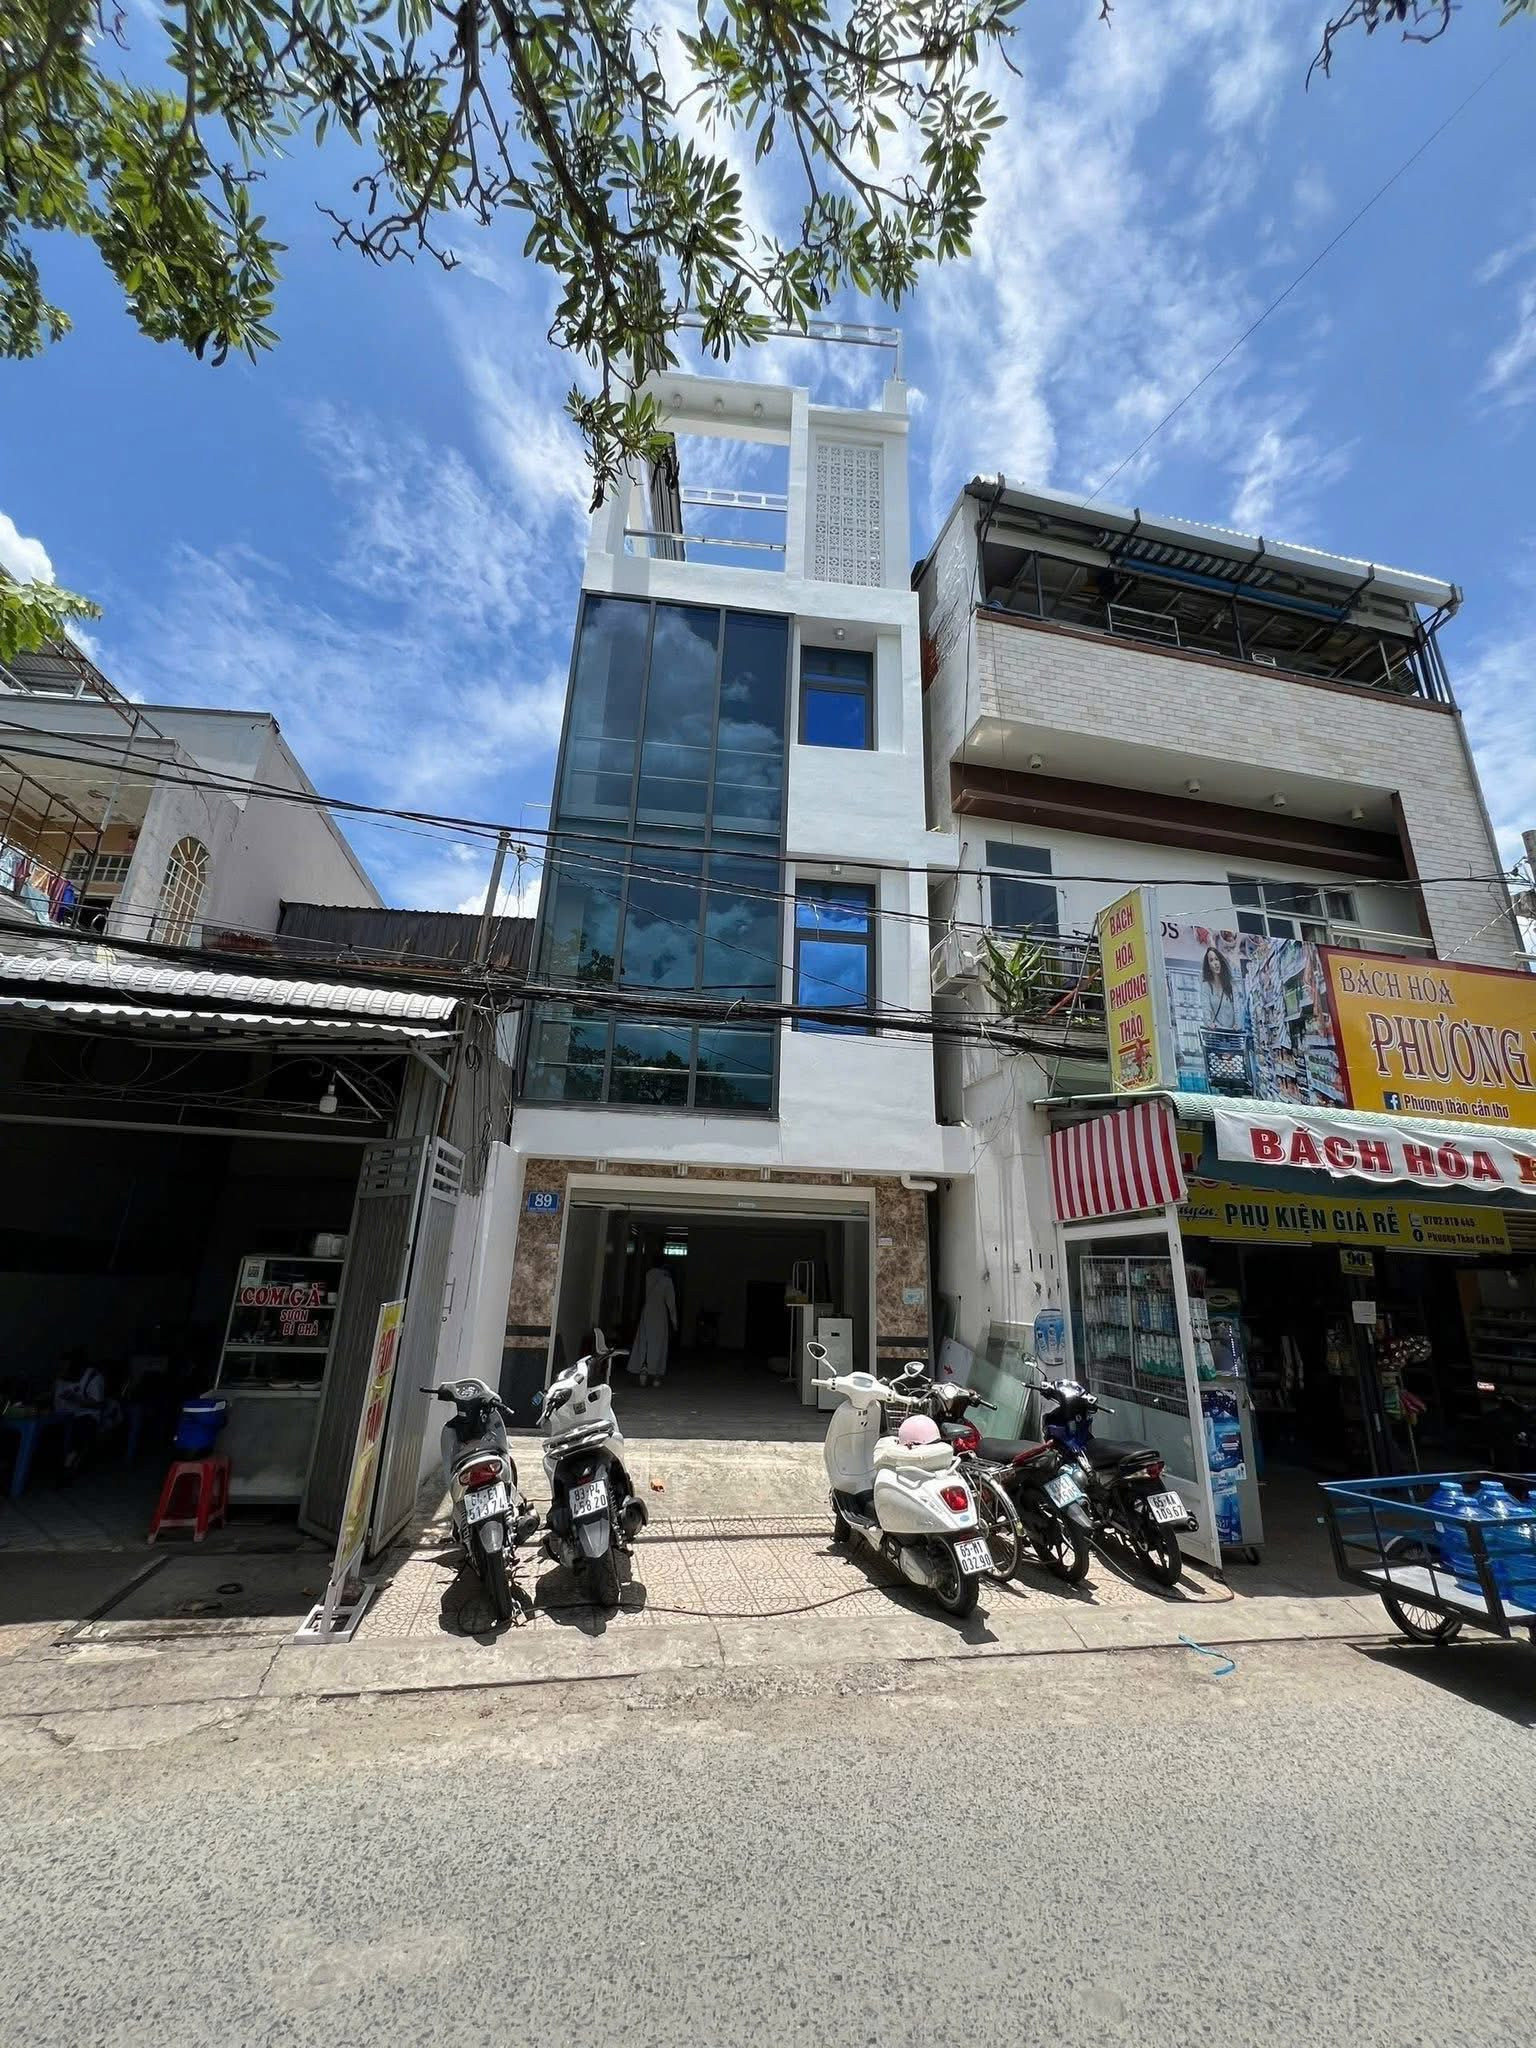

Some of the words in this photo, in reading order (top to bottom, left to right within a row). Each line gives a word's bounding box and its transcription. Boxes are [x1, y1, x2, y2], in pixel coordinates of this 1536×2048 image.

[1109, 904, 1135, 938] BÁCH
[1115, 941, 1135, 972] HÓA
[1338, 962, 1402, 999] BÁCH
[1407, 971, 1455, 1005] HÓA
[1367, 1013, 1534, 1090] PHƯƠNG
[1403, 1095, 1445, 1115] Phương
[1250, 1126, 1393, 1174] BÁCH
[1402, 1142, 1504, 1184] HÓA
[535, 1194, 552, 1207] 89
[1224, 1203, 1269, 1229] PHỤ
[1275, 1204, 1326, 1237] KIỆN
[1333, 1207, 1368, 1233] GIÁ
[1372, 1206, 1400, 1235] RẺ
[241, 1283, 288, 1306] CƠM
